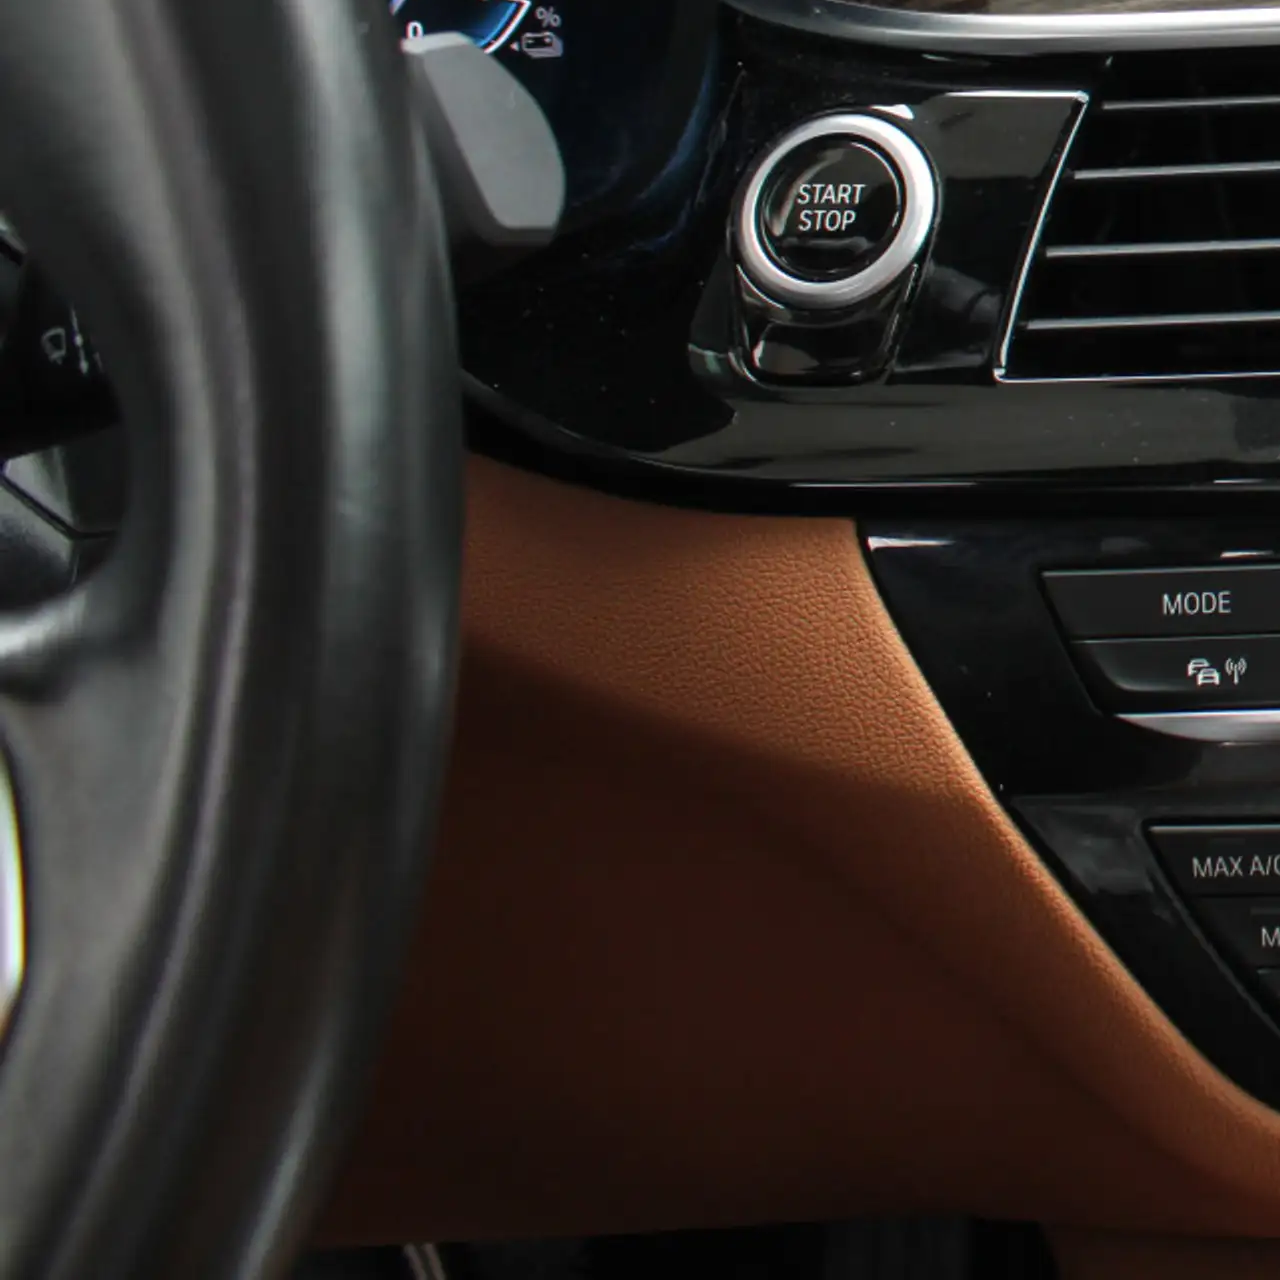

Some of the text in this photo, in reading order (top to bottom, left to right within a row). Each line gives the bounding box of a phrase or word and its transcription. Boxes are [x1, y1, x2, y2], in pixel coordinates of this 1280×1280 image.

[797, 182, 866, 206] START
[798, 209, 856, 232] STOP
[1161, 590, 1232, 616] MODE
[1191, 854, 1244, 879] MAX
